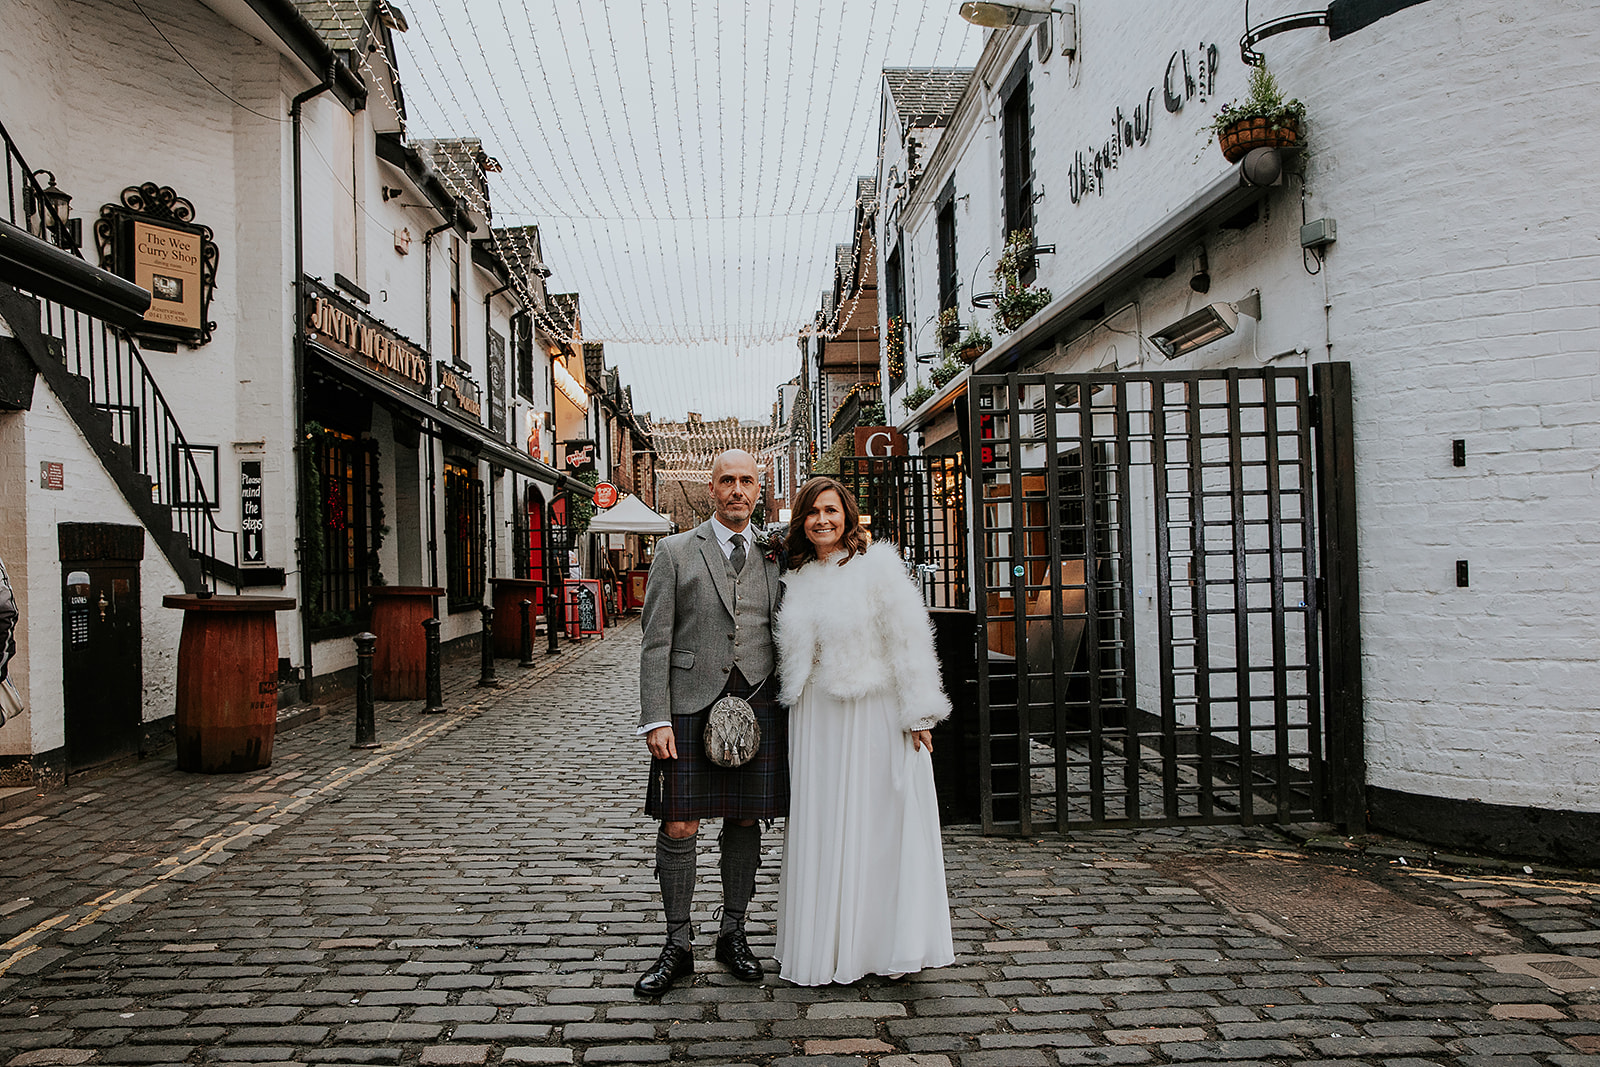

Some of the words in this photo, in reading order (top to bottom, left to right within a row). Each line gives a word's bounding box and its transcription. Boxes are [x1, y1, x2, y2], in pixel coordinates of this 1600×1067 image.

[1163, 41, 1218, 114] Chip
[145, 232, 166, 246] The
[168, 237, 191, 251] Wee
[138, 242, 168, 260] Curry
[171, 249, 198, 266] Shop
[865, 432, 894, 457] G
[241, 473, 262, 485] Please
[241, 485, 261, 497] mind
[244, 500, 259, 514] the
[242, 516, 263, 534] steps
